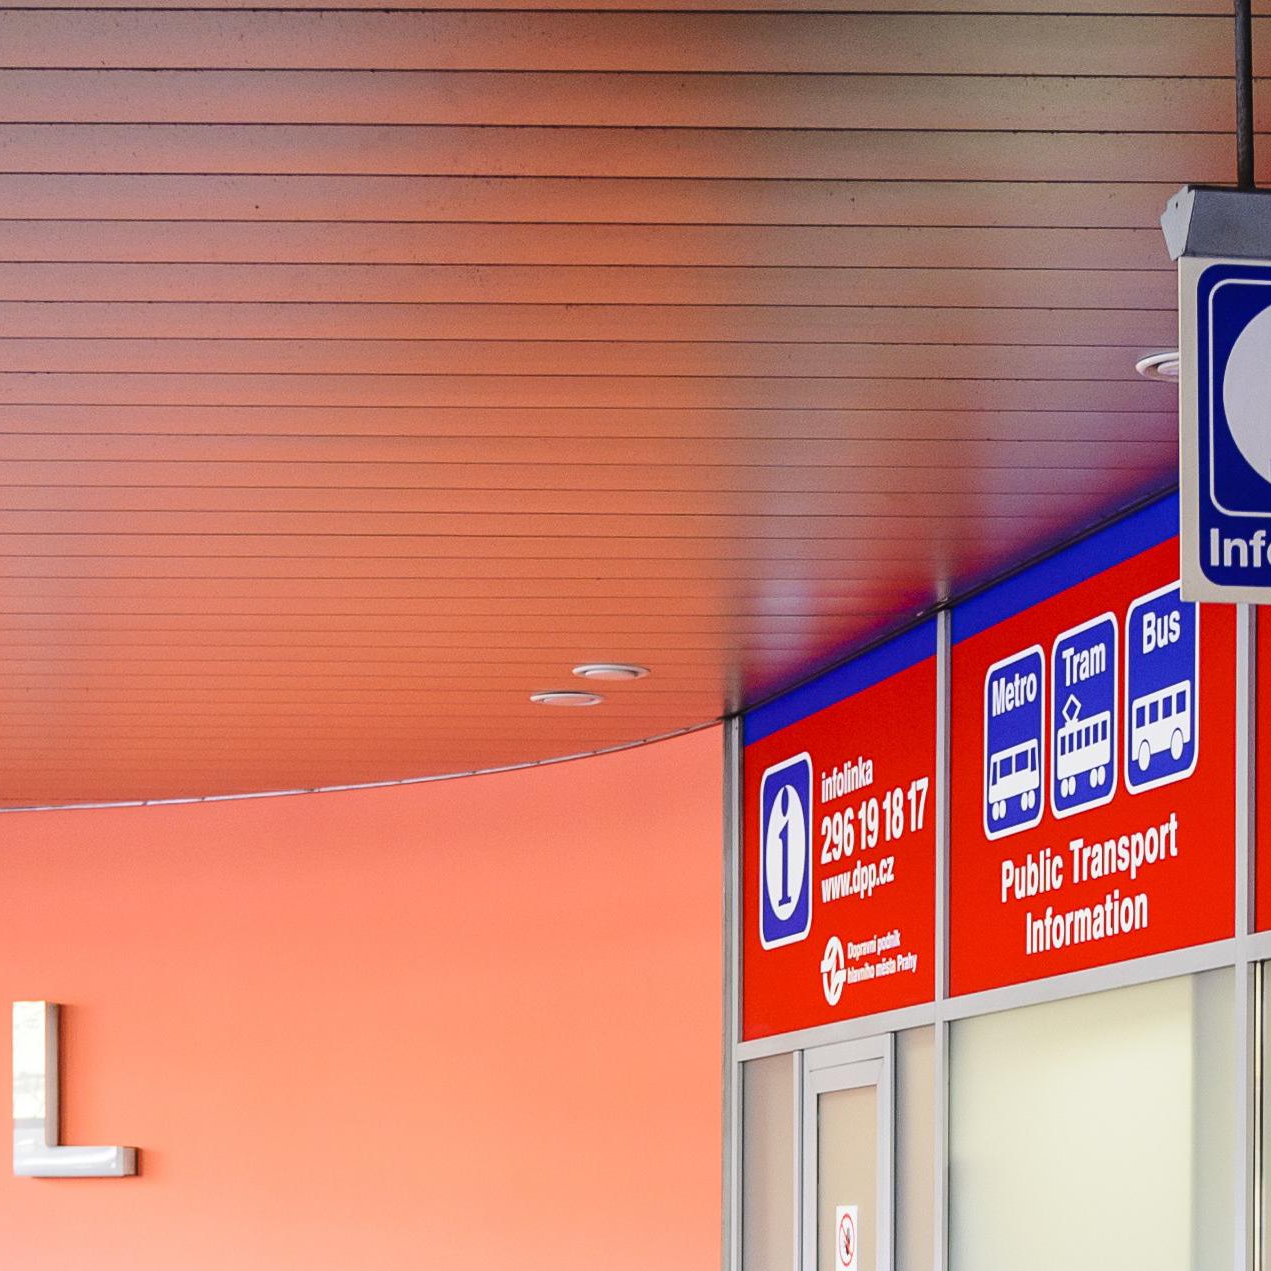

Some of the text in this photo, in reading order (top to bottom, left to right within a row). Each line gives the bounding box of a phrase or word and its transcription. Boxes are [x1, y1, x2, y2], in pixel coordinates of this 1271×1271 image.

[1142, 610, 1181, 655] Bus
[1061, 642, 1106, 687] Tram
[991, 672, 1038, 718] Metro
[821, 755, 874, 804] infolinka
[820, 776, 929, 865] 296 19 18 17
[821, 855, 895, 904] www.dpp.cz
[1001, 812, 1178, 904] Public Transport
[1025, 888, 1149, 956] Information
[896, 951, 918, 974] Prahy
